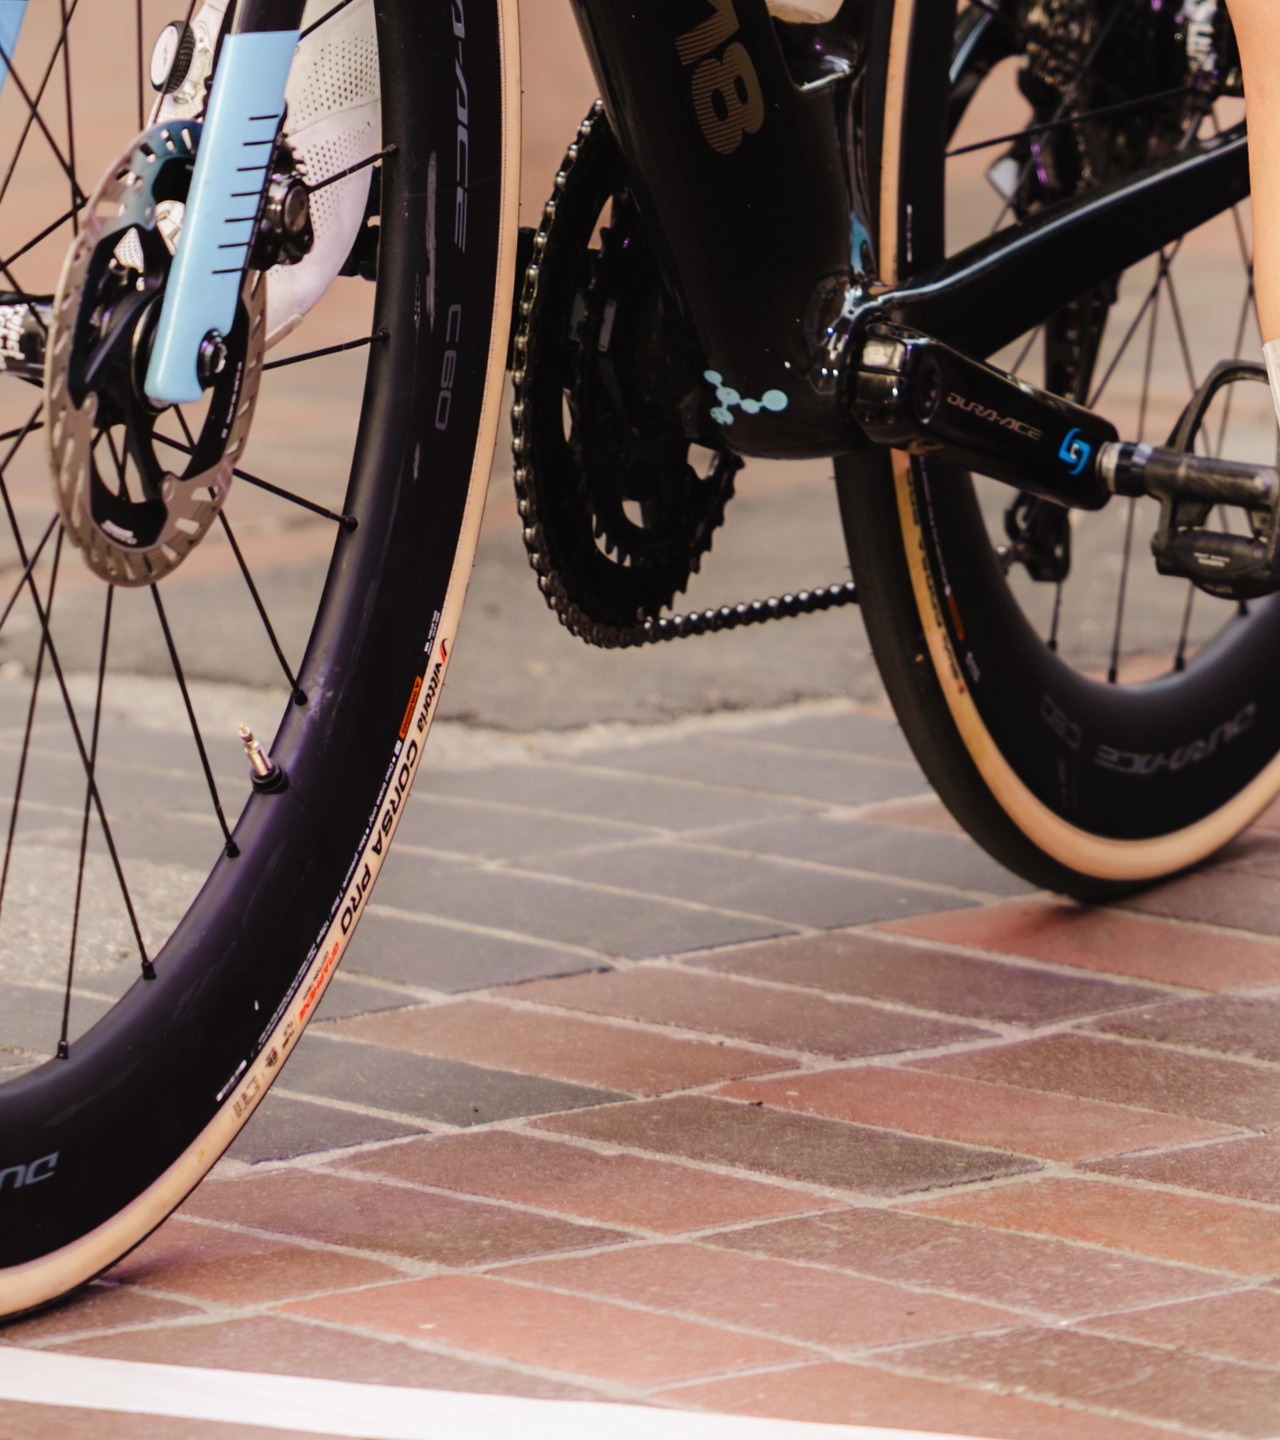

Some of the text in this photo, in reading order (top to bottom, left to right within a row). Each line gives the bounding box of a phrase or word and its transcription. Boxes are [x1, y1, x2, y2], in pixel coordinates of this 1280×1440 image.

[947, 392, 1043, 441] DURA-ACE
[417, 663, 442, 733] vittoria
[372, 739, 418, 856] CORSA
[341, 863, 371, 935] PRO
[299, 942, 339, 1022] GRAPHENE
